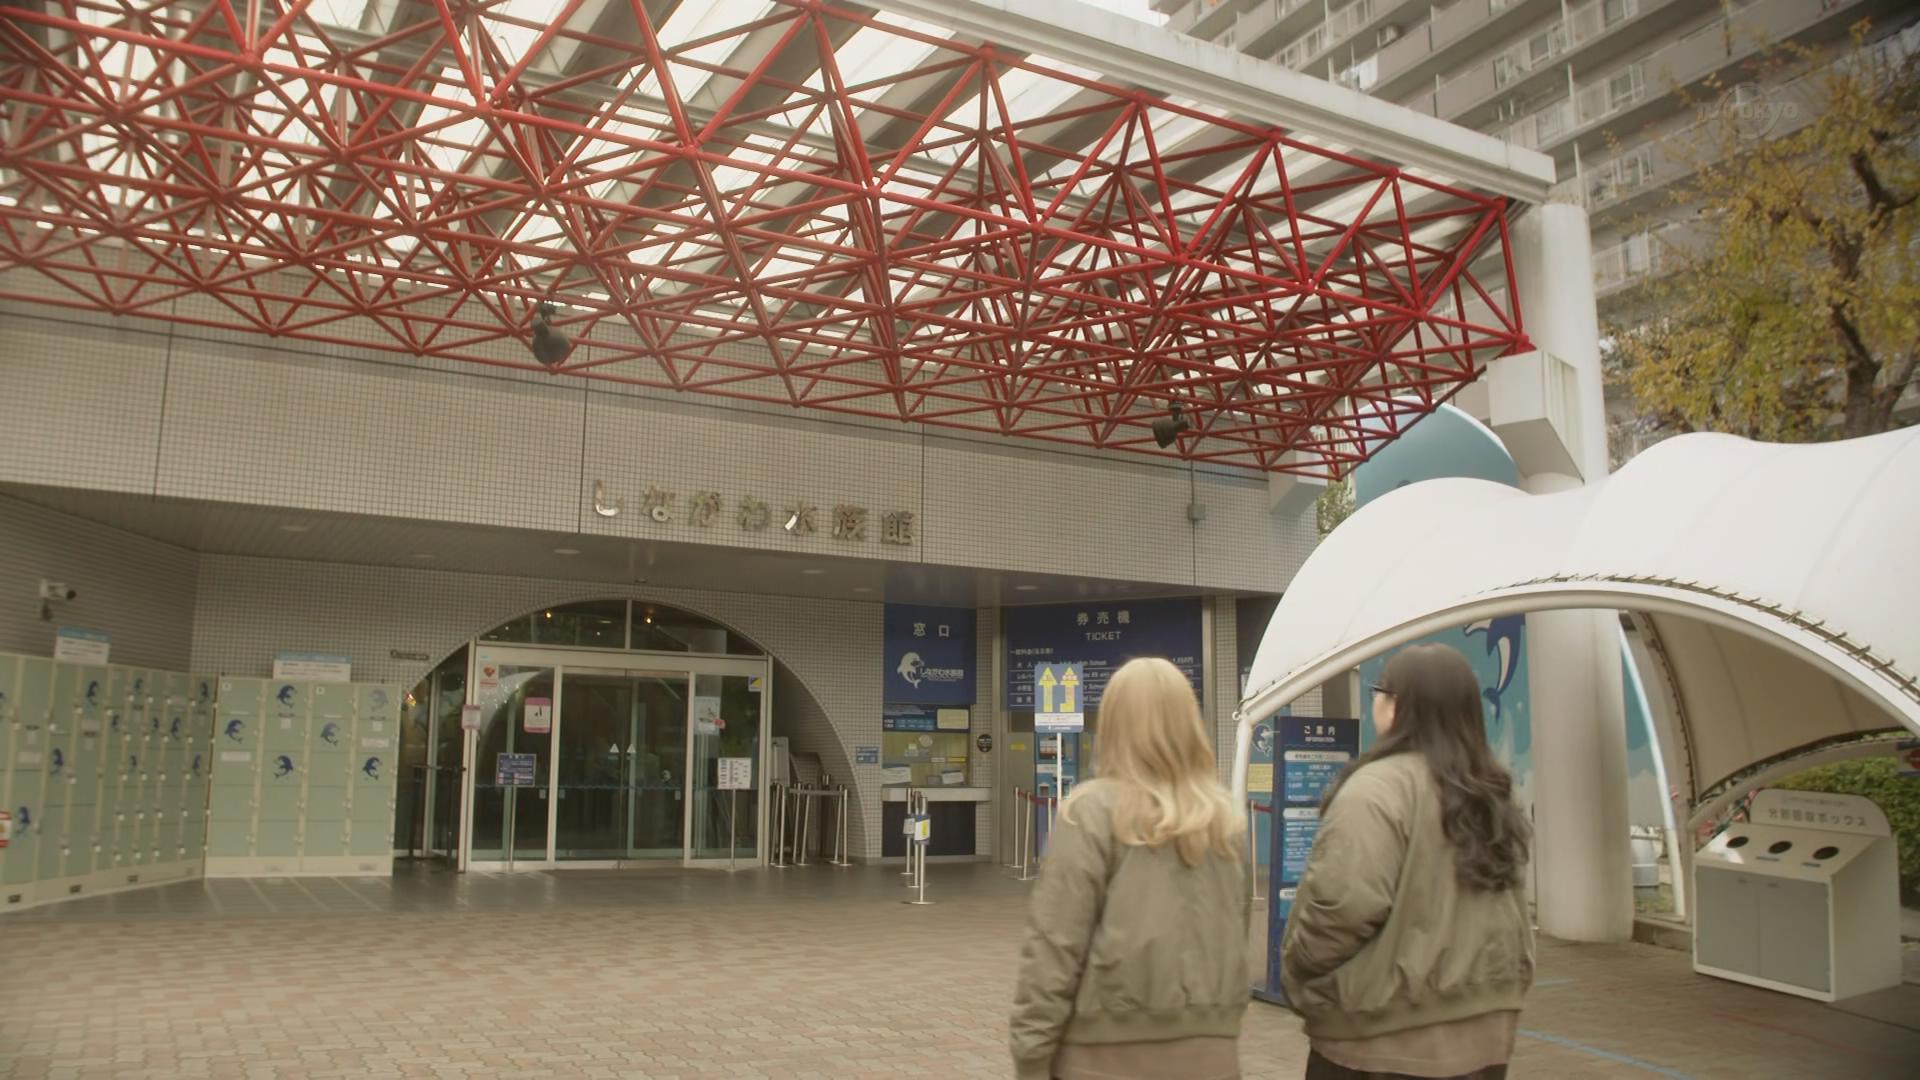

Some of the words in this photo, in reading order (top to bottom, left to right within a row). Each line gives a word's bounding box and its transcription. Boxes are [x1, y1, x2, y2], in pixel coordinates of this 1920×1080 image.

[594, 478, 915, 547] しながわ水族館
[913, 622, 950, 637] 窓口
[1085, 631, 1122, 641] TICKET
